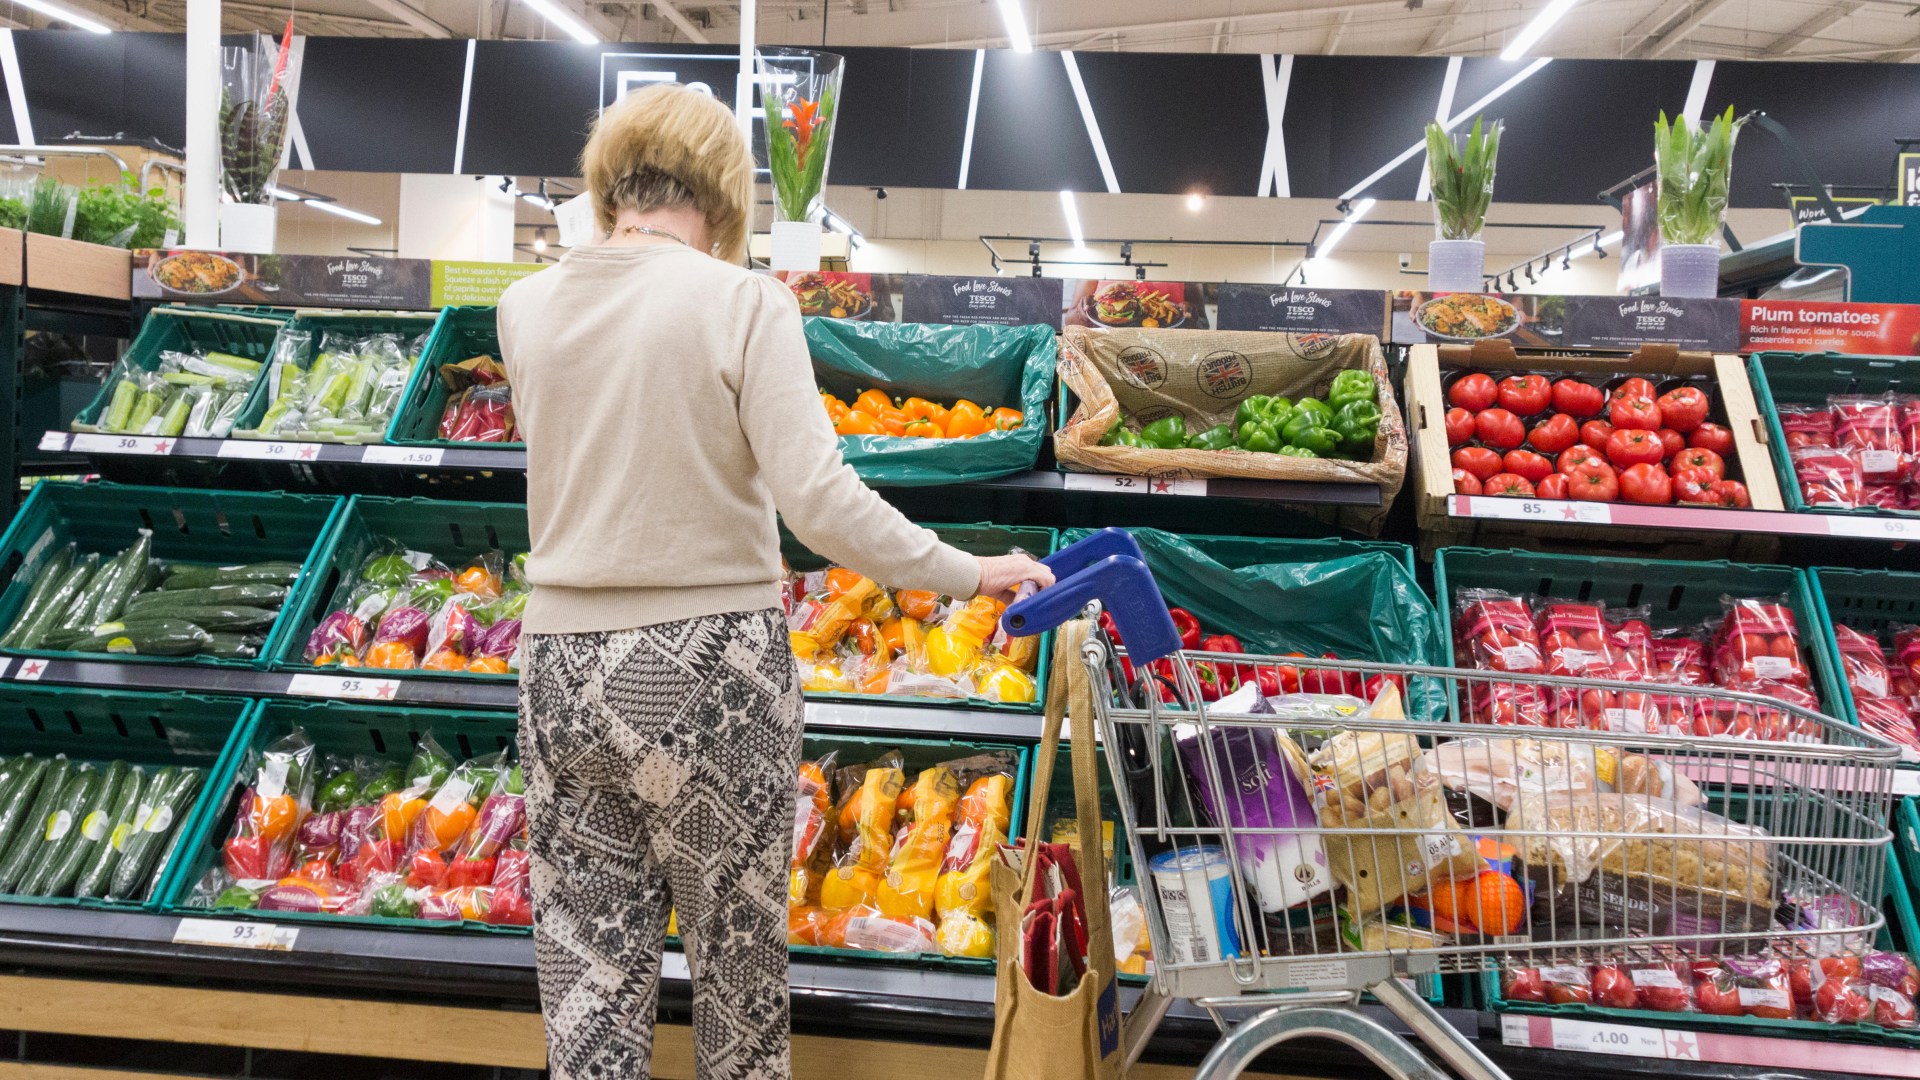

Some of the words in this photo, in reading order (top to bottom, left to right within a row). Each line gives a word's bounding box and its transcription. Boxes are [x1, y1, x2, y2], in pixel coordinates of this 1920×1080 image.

[327, 261, 344, 275] Food
[345, 260, 359, 272] Love
[359, 261, 383, 279] Stories
[445, 273, 474, 283] Squeeze
[953, 282, 971, 296] Food
[973, 280, 987, 292] Love
[987, 281, 1012, 296] Stories
[461, 294, 492, 302] delicious
[1270, 293, 1289, 307] Food
[1290, 291, 1305, 303] Love
[1305, 291, 1331, 307] Stories
[1619, 302, 1638, 317] Food
[1640, 300, 1656, 313] Love
[1656, 301, 1683, 317] Stories
[1751, 306, 1794, 322] Plum
[1798, 308, 1880, 324] tomatoes
[1750, 325, 1769, 334] Rich
[1771, 326, 1779, 334] in
[1780, 326, 1811, 336] flavour,
[1814, 327, 1834, 335] ideal
[1836, 328, 1848, 336] for
[1750, 337, 1795, 345] casseroles
[1796, 337, 1813, 345] and
[1814, 338, 1847, 347] curries.
[1202, 353, 1238, 373] PRODUCE
[1212, 377, 1247, 396] BRITISH
[1592, 1031, 1629, 1045] £1.00
[1640, 1037, 1657, 1046] New
